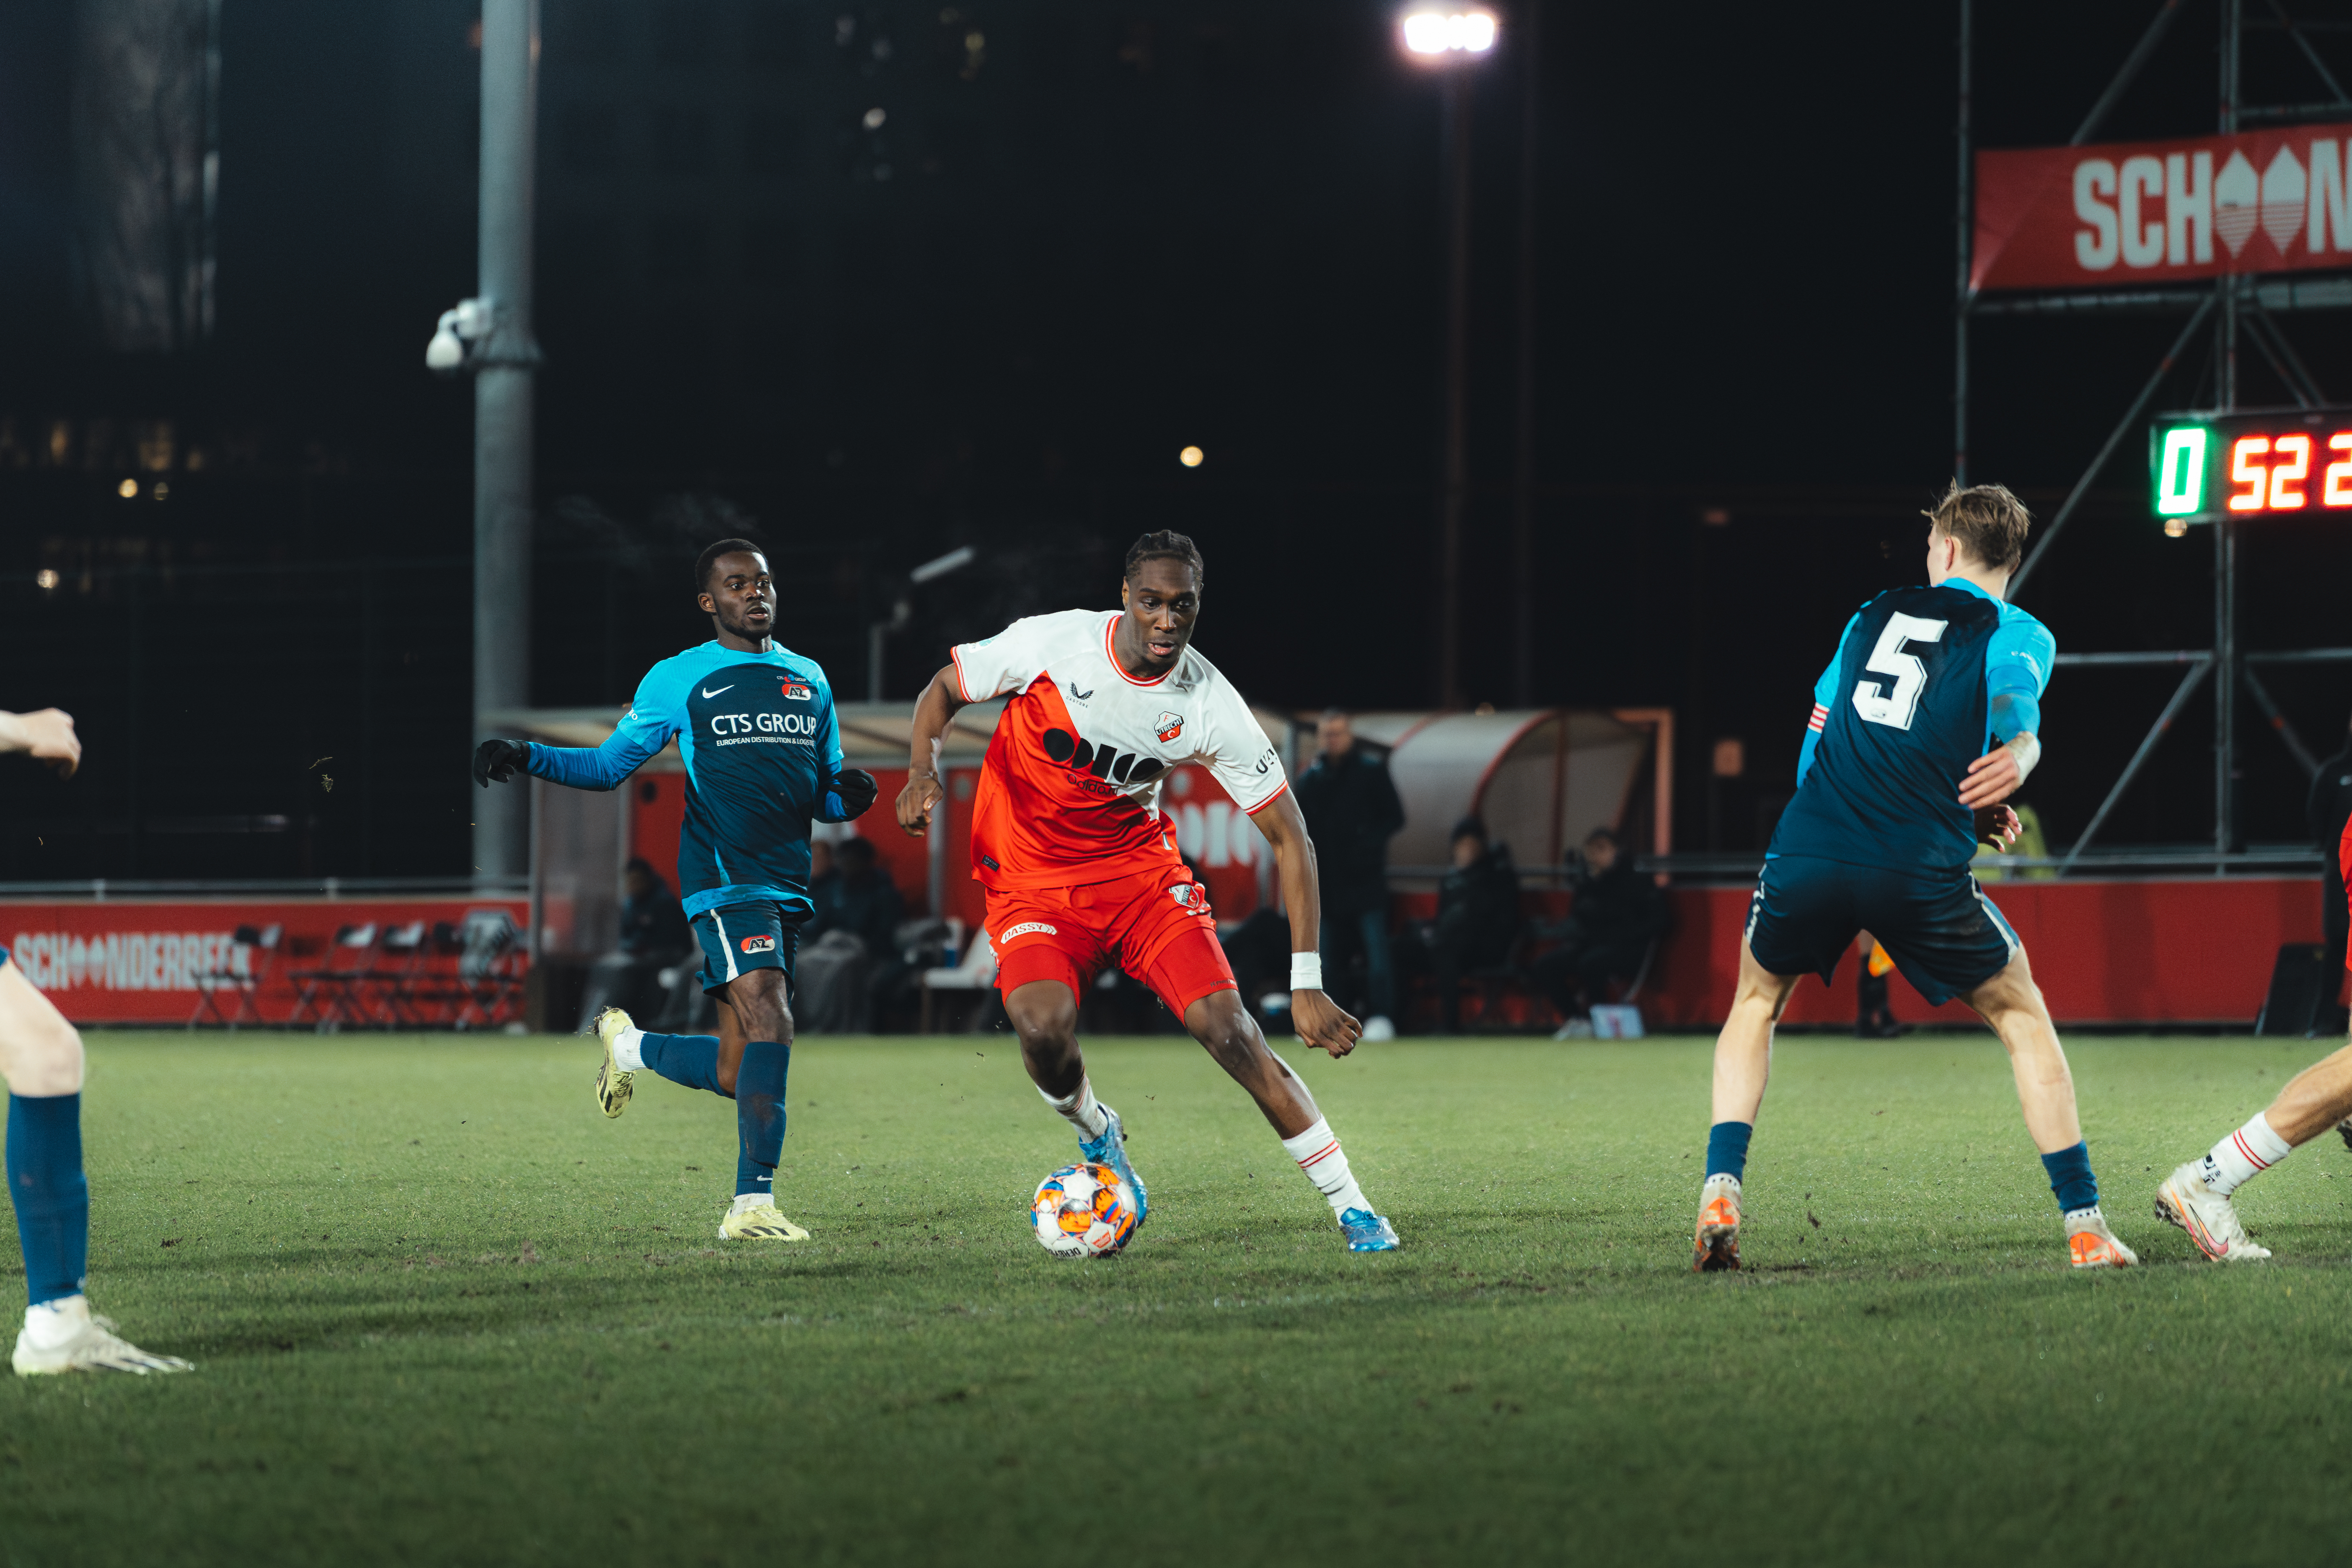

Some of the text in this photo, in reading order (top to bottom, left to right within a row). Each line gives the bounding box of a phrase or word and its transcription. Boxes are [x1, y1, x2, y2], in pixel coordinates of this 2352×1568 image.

[2158, 427, 2207, 515] 0
[2229, 433, 2310, 510] 52
[1852, 611, 1948, 730] 5
[788, 686, 808, 699] AZ
[1066, 696, 1089, 708] CASTORE
[712, 713, 816, 735] CTS GROUP
[1156, 717, 1182, 735] UTRECHT
[716, 737, 750, 746] EUROPEAN
[1005, 924, 1043, 941] DASSY
[748, 937, 771, 952] AZ
